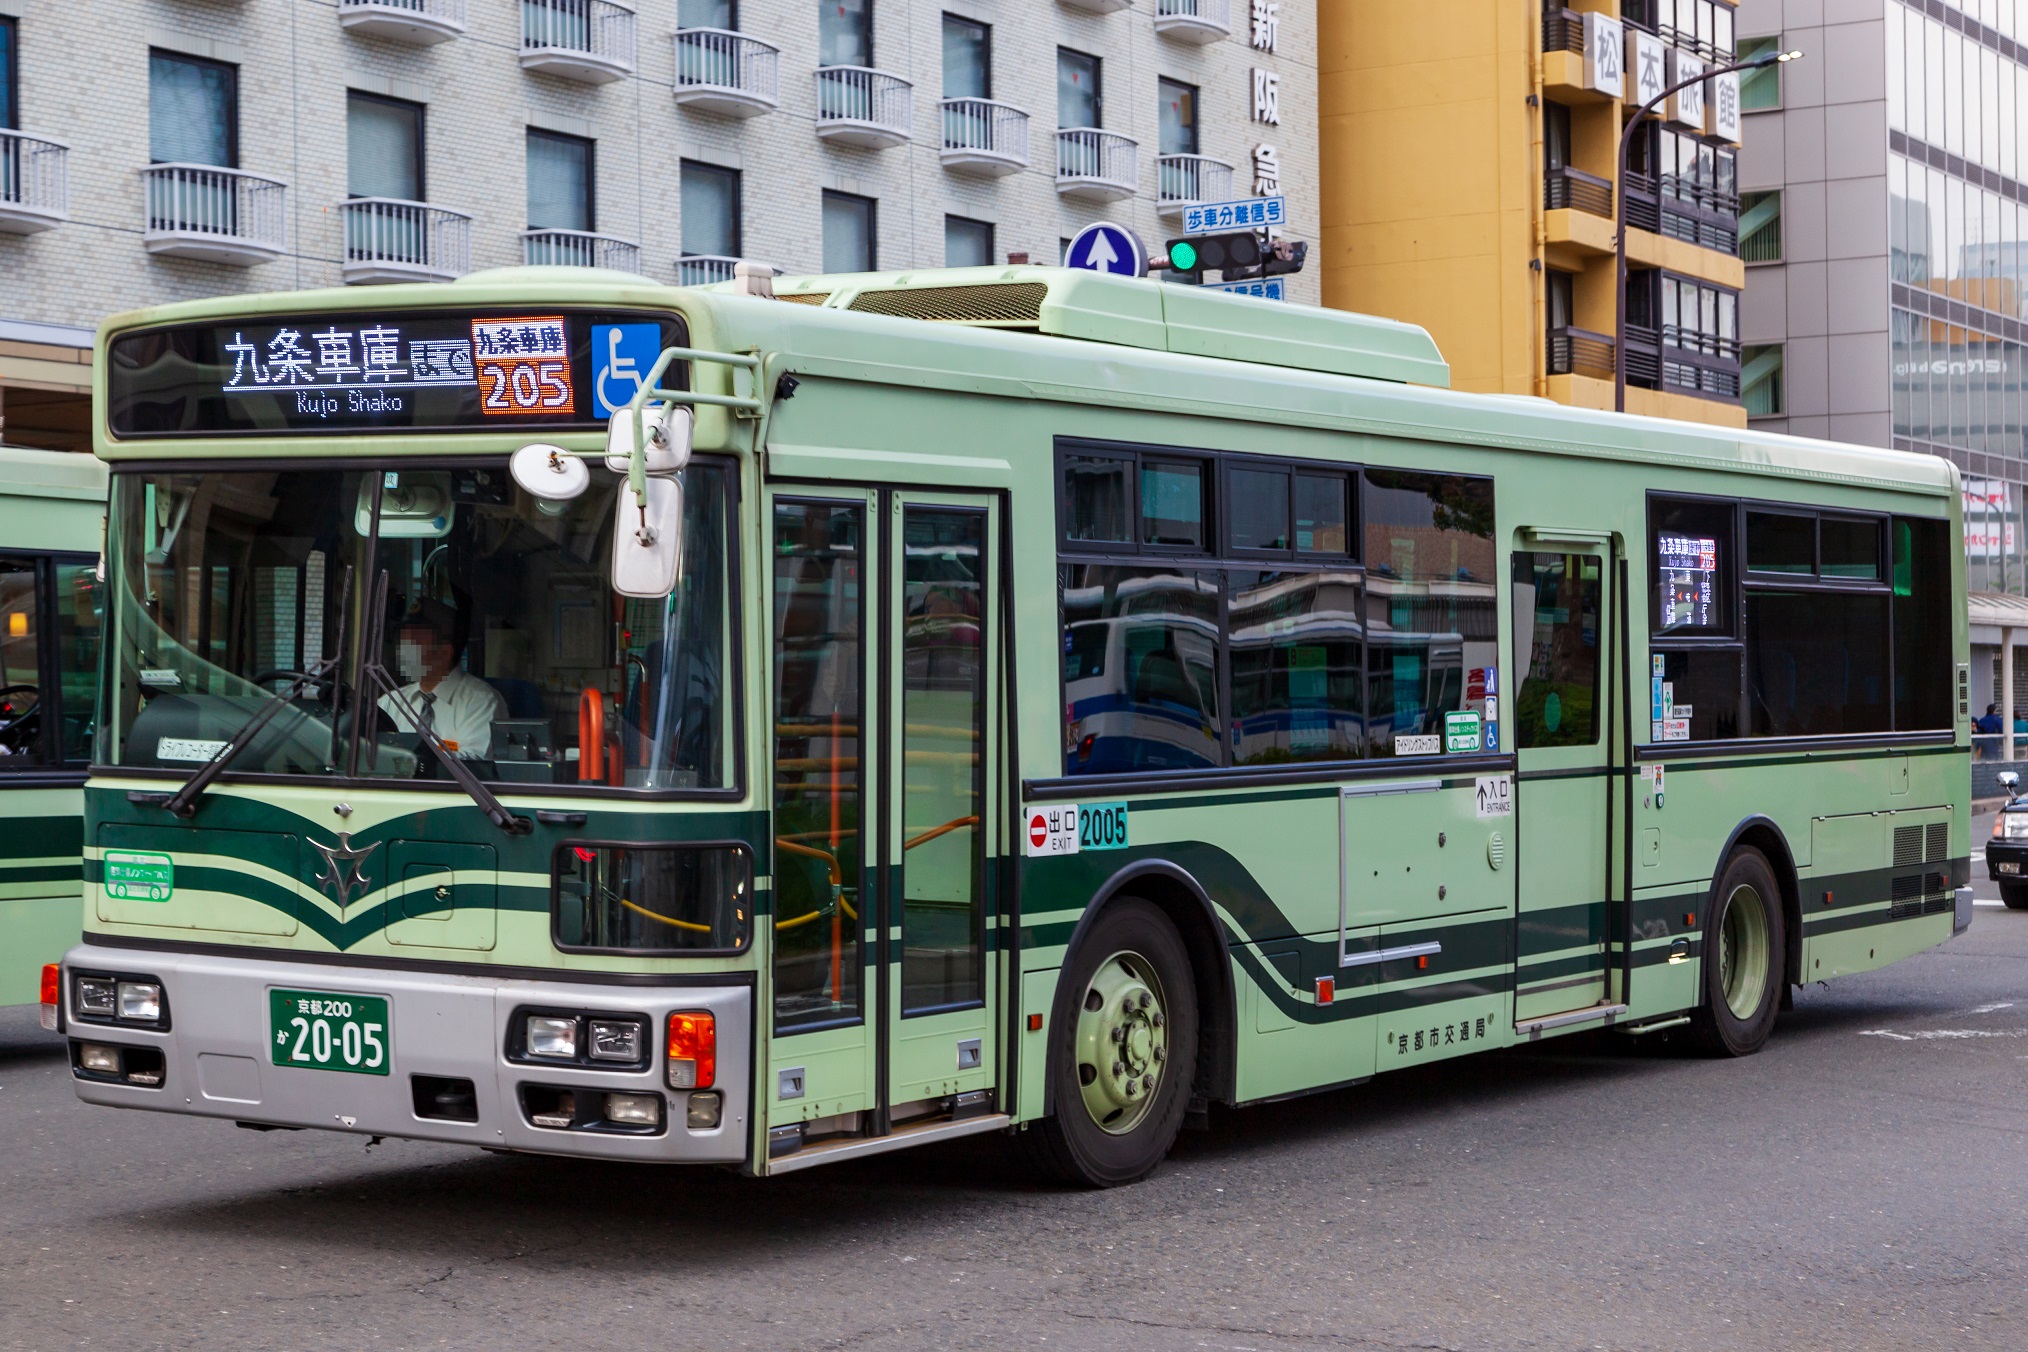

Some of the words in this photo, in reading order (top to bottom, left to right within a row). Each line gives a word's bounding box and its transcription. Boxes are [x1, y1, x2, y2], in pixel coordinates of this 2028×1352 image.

[1597, 26, 1736, 129] 松本旅館
[1187, 201, 1281, 230] 歩車分離信号
[476, 326, 564, 355] 九条車庫
[483, 363, 569, 407] 205
[296, 390, 338, 418] Kujo
[348, 389, 402, 412] Shako
[1490, 780, 1507, 799] 入口
[1049, 810, 1075, 833] 出口
[1487, 801, 1511, 813] ENTRANCE
[1080, 807, 1126, 846] 2005
[1052, 837, 1072, 850] EXIT
[276, 1029, 290, 1045] か
[290, 1016, 384, 1068] 20-05
[1397, 1017, 1486, 1055] 京都市交通局
